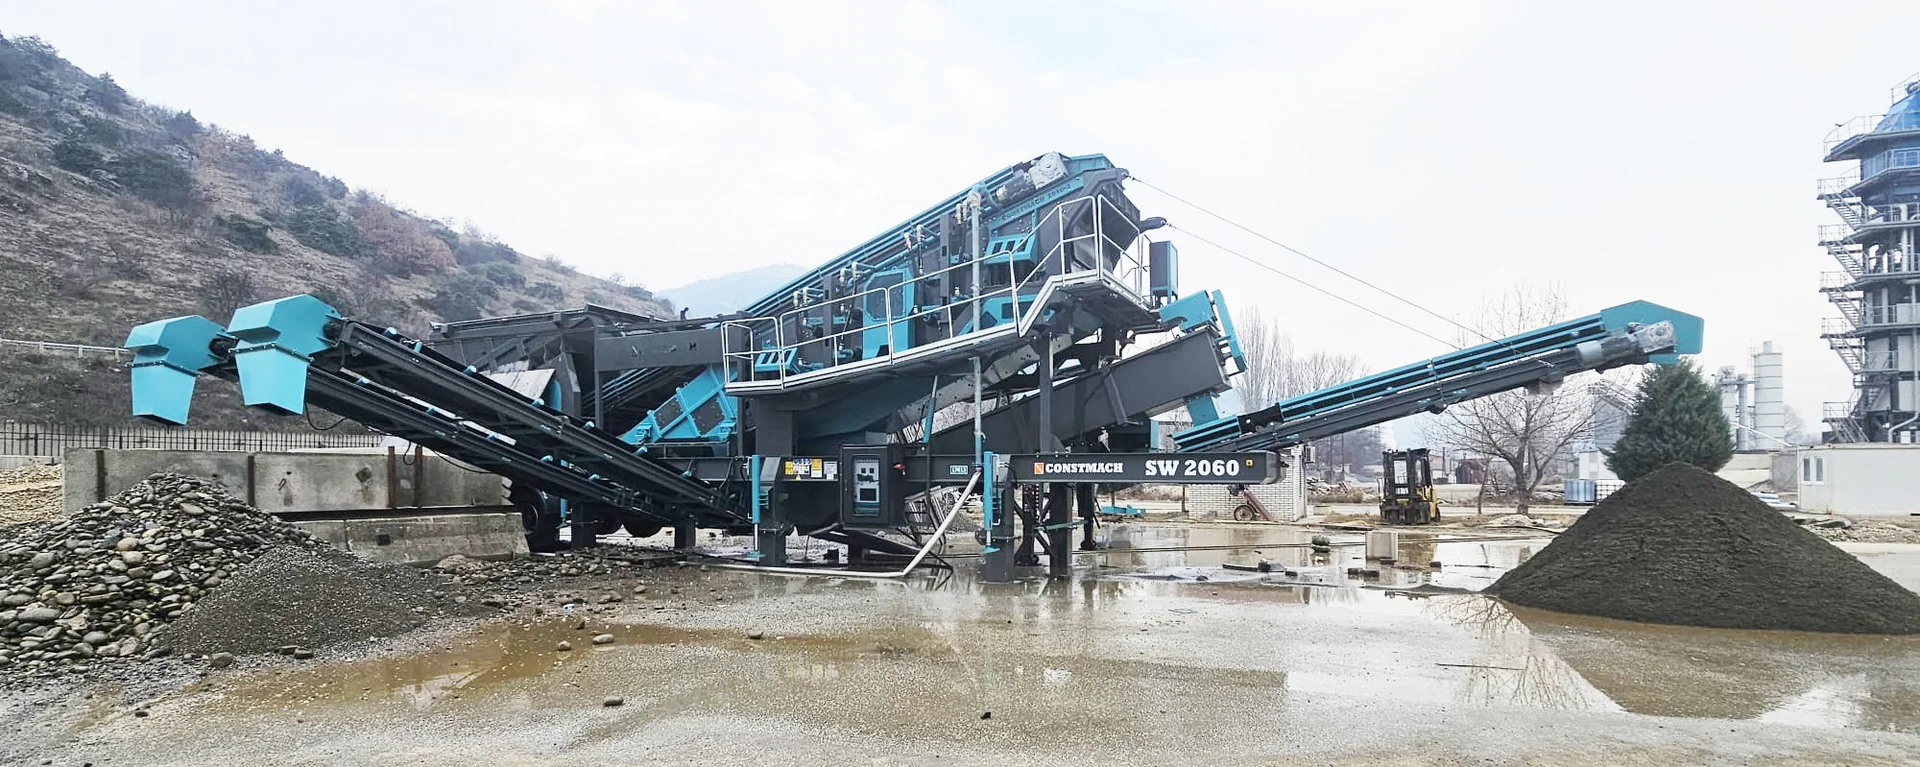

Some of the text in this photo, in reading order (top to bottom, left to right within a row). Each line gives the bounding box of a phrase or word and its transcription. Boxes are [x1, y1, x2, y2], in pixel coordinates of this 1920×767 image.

[1045, 460, 1240, 476] CONSTMACH SW 2060
